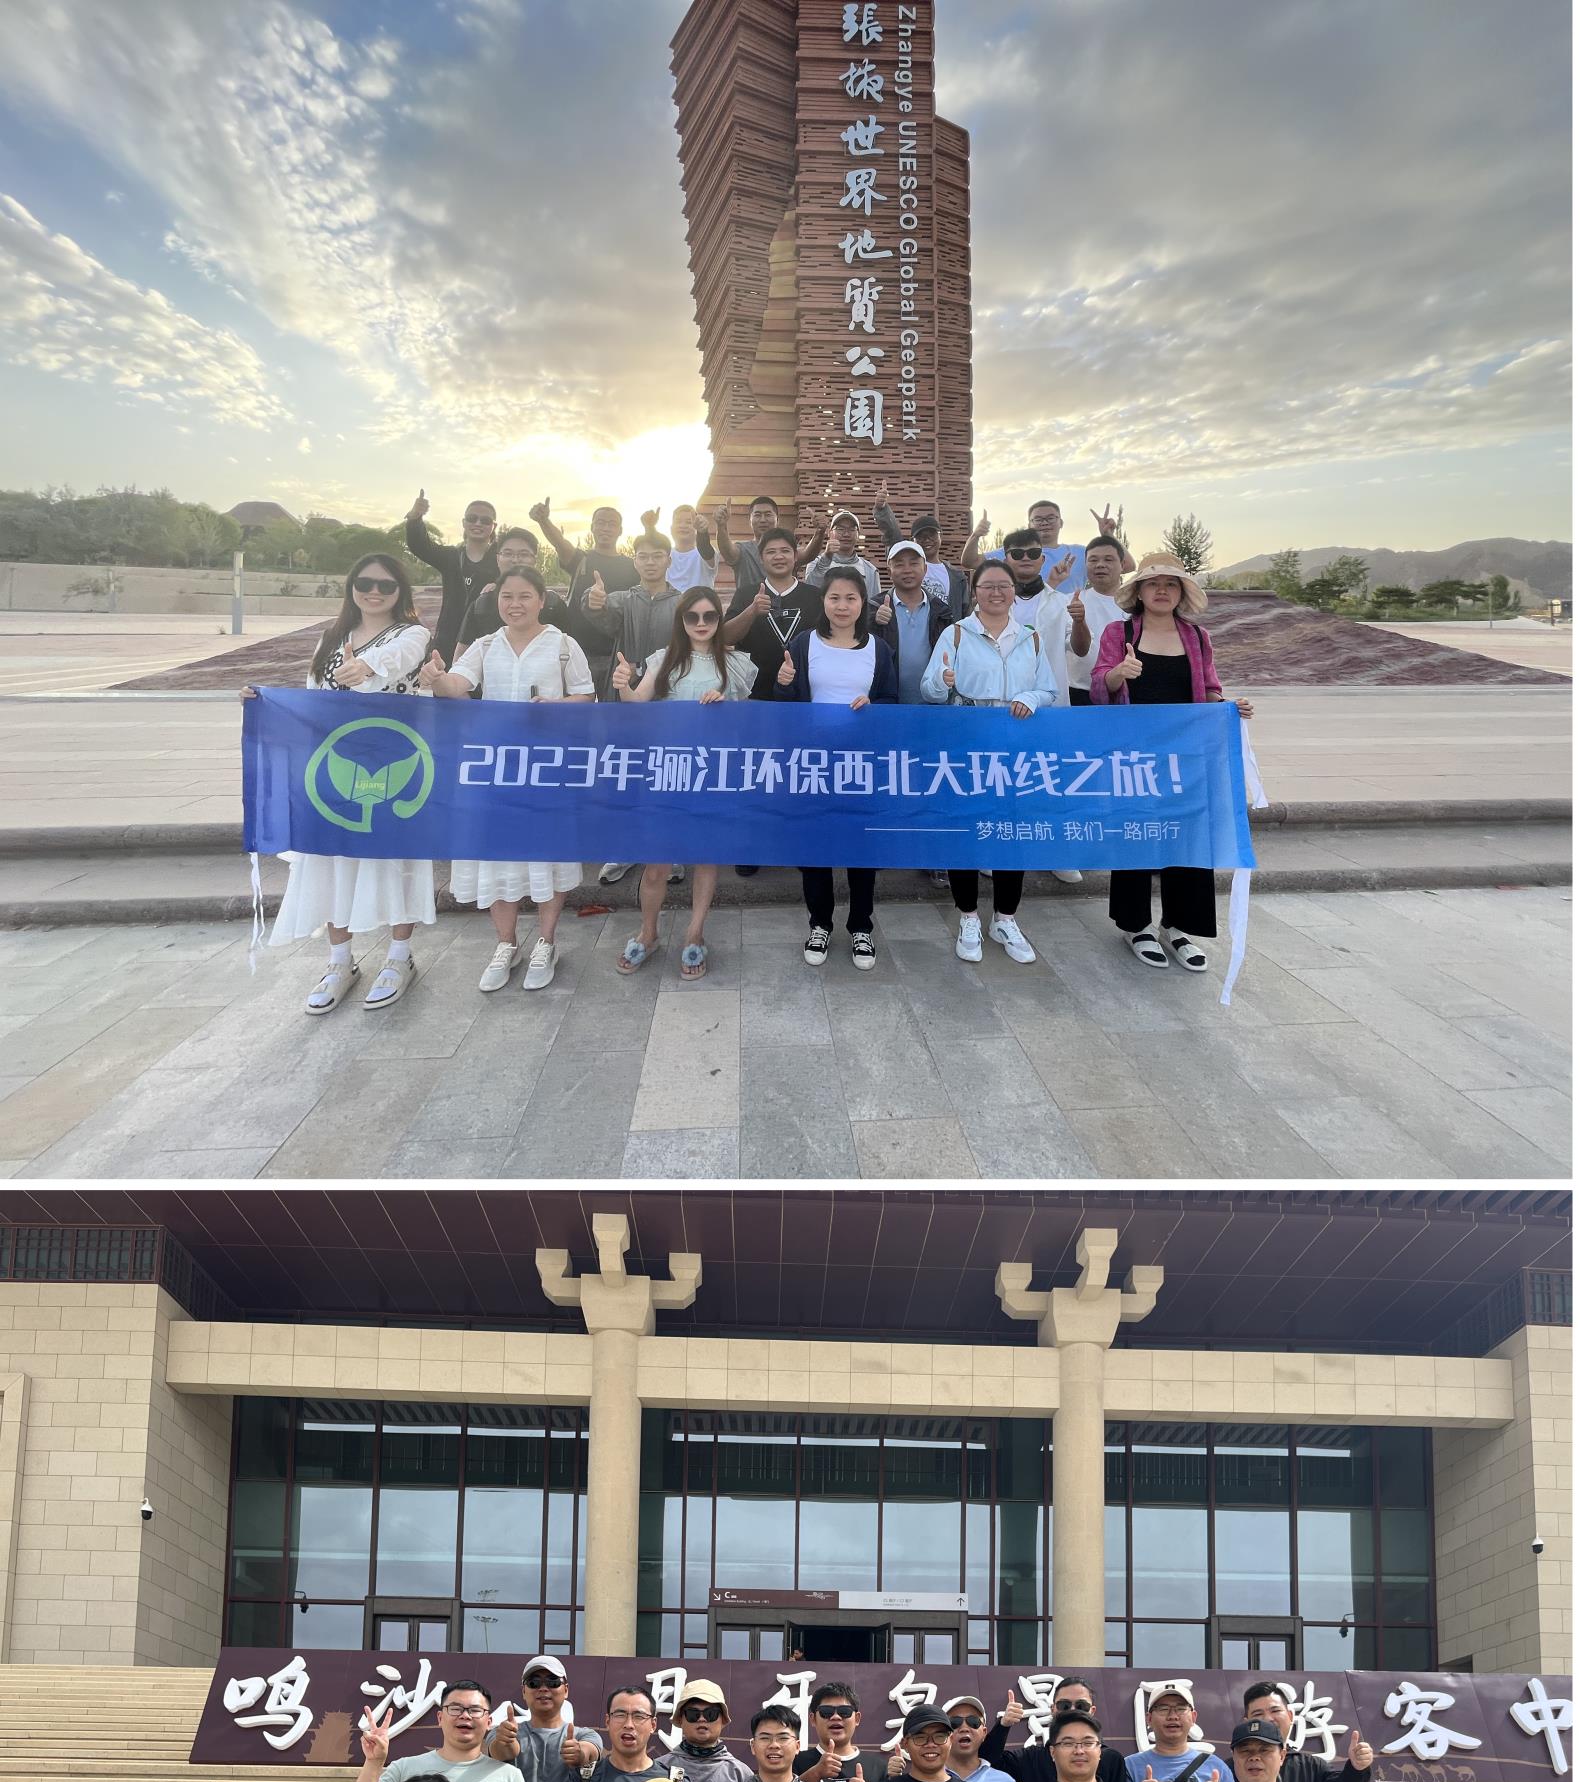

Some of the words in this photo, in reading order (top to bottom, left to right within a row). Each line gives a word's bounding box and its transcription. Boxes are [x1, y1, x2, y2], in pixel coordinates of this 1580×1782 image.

[894, 5, 916, 113] Zhangye
[898, 121, 917, 230] UNESCO
[899, 237, 919, 321] Global
[897, 329, 921, 441] Geopark
[354, 779, 386, 791] Lijiang
[459, 744, 1182, 797] 2023年骊江环保西北大环线之旅！
[976, 820, 1055, 841] 梦想启航
[1064, 820, 1181, 842] 我们一路同行
